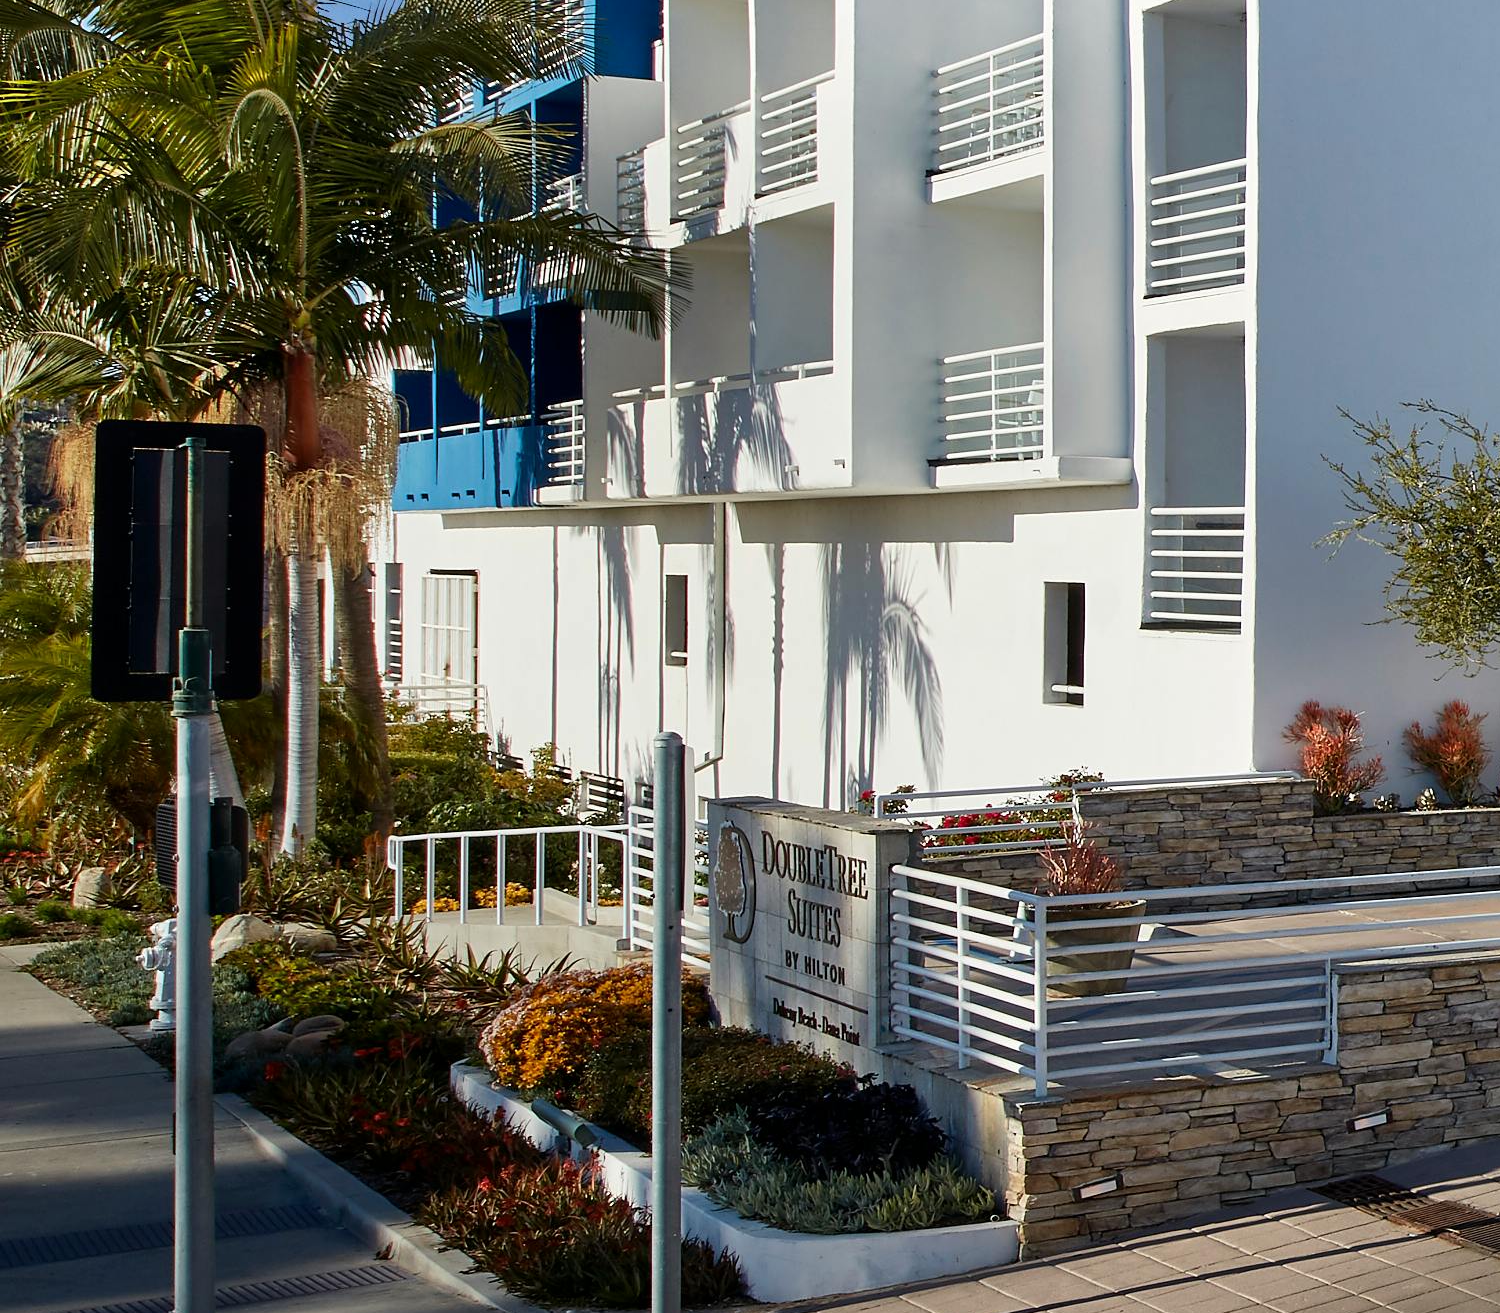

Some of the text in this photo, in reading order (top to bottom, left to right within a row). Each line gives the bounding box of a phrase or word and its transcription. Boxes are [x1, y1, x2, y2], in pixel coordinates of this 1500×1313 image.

[788, 888, 841, 947] SUITES
[785, 949, 845, 986] BY HILTON
